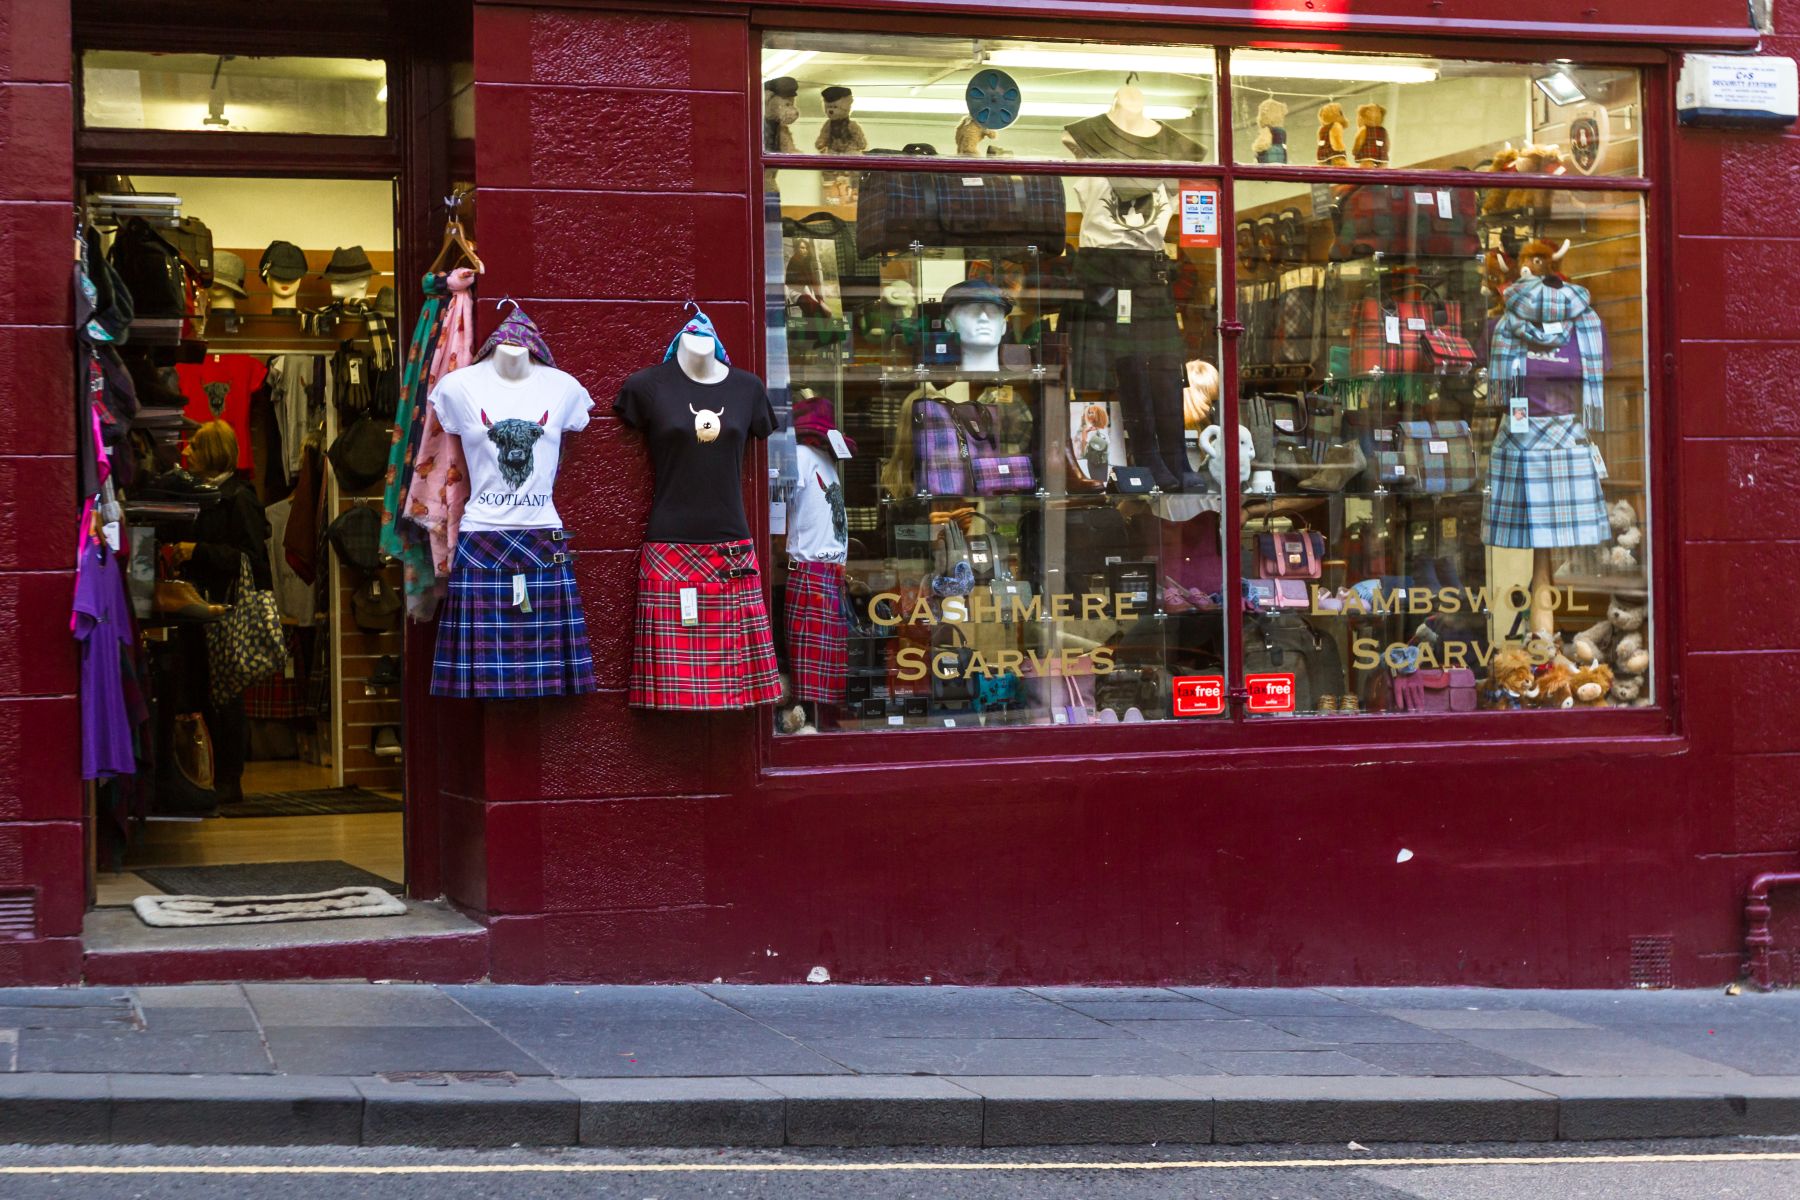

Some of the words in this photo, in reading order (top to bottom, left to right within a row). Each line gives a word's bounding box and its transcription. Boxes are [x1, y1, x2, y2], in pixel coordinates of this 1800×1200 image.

[868, 592, 1139, 626] CASHMERE
[1310, 583, 1590, 616] LAMBSWOOL
[896, 646, 1115, 681] SCARVES
[1352, 637, 1550, 670] SCARVES
